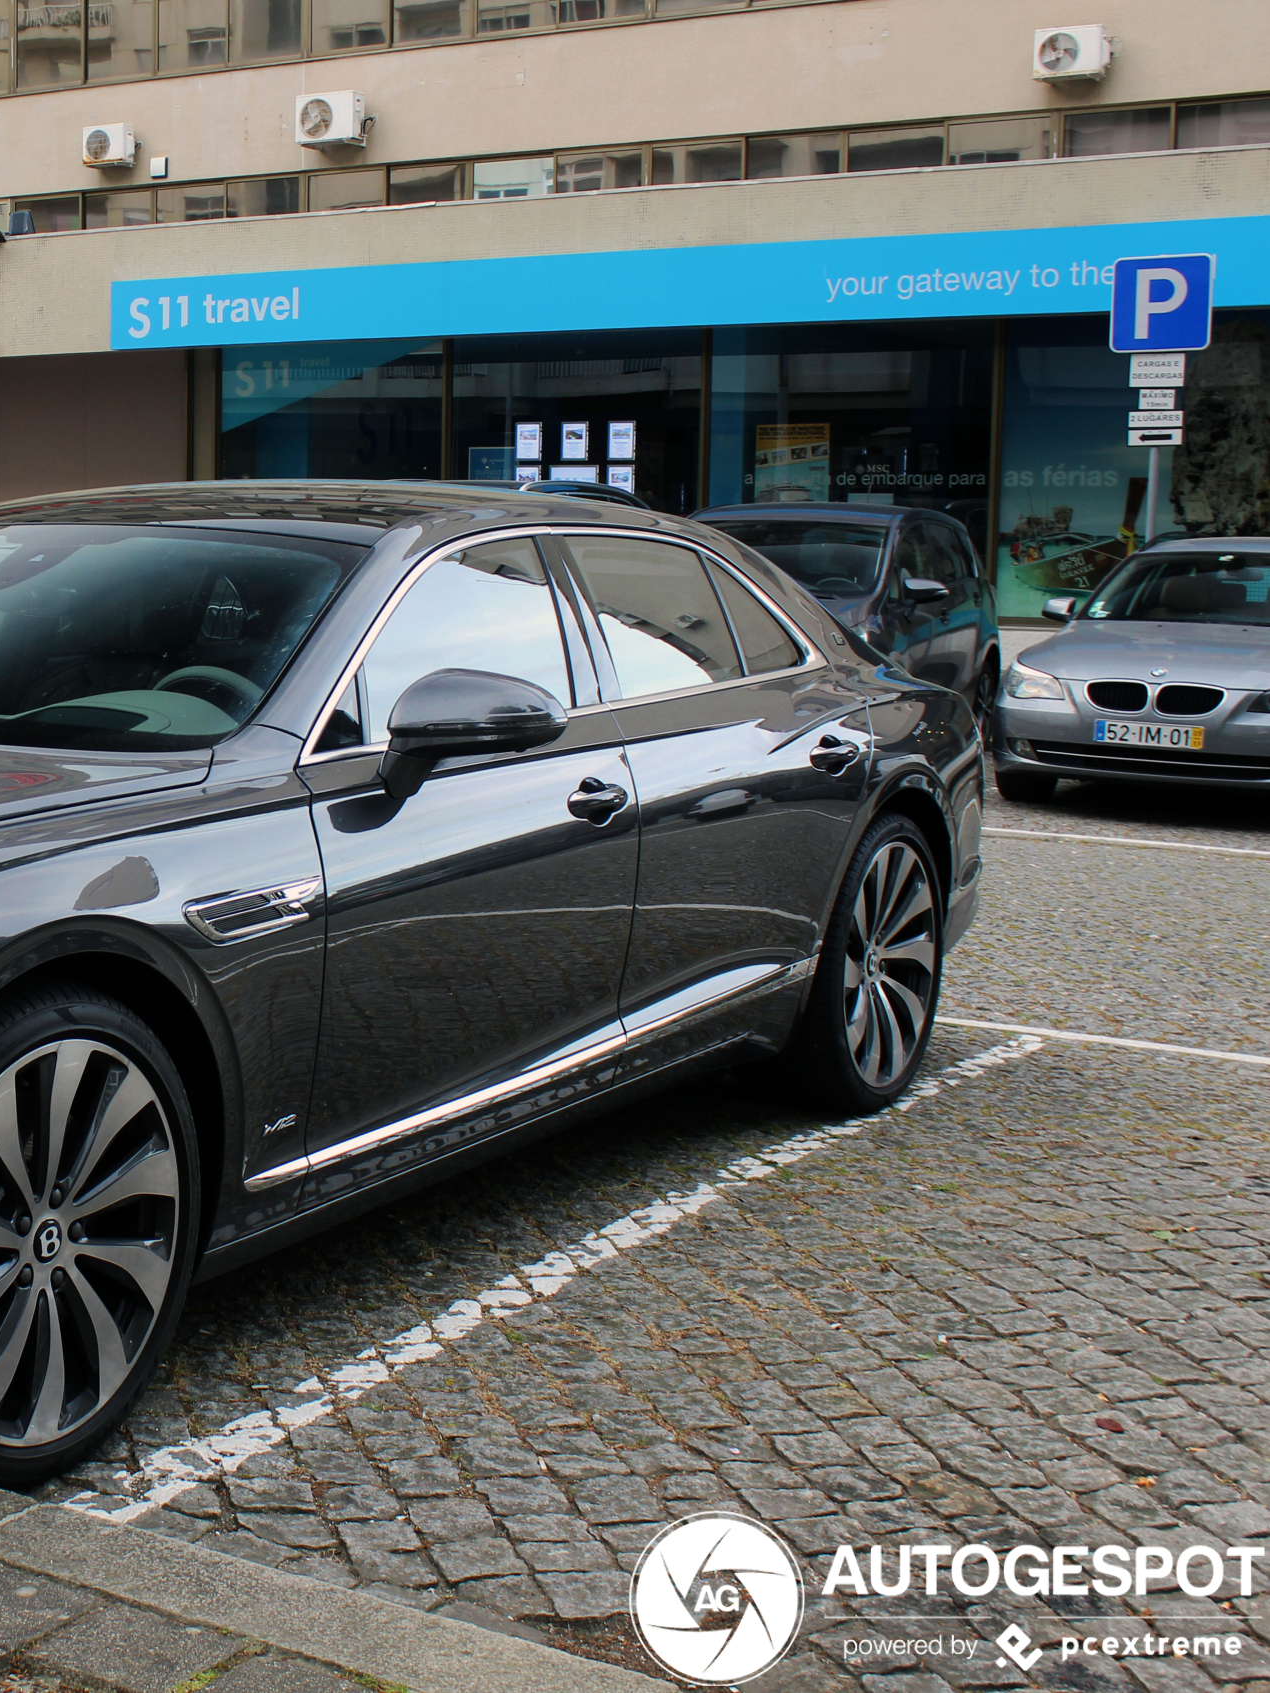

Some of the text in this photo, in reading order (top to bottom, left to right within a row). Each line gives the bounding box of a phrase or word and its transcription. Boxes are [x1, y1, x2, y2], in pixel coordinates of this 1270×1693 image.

[826, 260, 1114, 303] your gateway to the
[203, 286, 300, 324] travel
[1134, 267, 1188, 340] P
[300, 355, 331, 369] travel
[1137, 360, 1172, 368] CARGAS
[1132, 372, 1183, 380] DESCARGAS
[1137, 414, 1181, 422] LUGARES
[866, 464, 890, 473] MSC
[744, 474, 754, 485] a
[836, 472, 856, 485] de
[861, 472, 943, 489] embarque
[949, 474, 986, 488] para
[1004, 469, 1034, 487] as
[1041, 463, 1118, 487] férias
